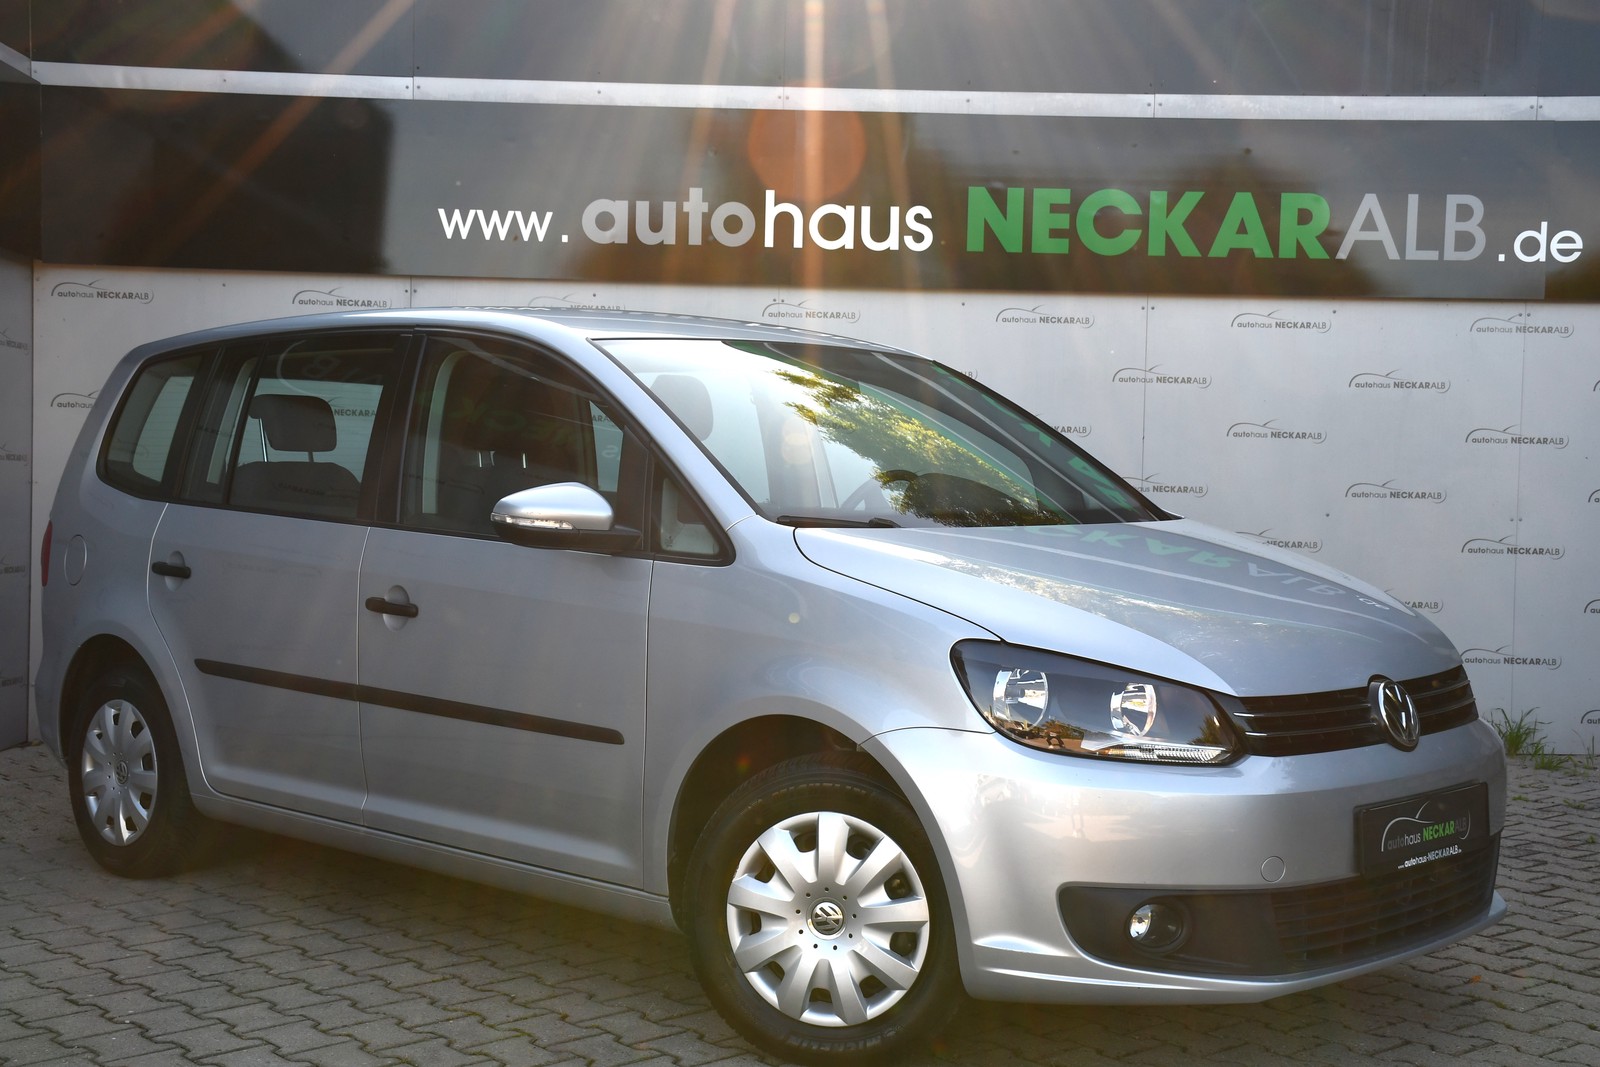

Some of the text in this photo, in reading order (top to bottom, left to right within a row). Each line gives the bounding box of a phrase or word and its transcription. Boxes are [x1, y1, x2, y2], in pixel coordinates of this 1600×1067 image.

[582, 187, 934, 252] autohaus
[965, 185, 1487, 262] NECKARALB
[1498, 221, 1584, 263] .de
[57, 290, 149, 301] autohaus NECKARALB
[298, 298, 388, 308] autohaus NECKARALB
[1040, 316, 1091, 325] NECKARALB
[1275, 321, 1326, 330] NECKARALB
[1516, 325, 1569, 335] NECKARALB
[1119, 376, 1207, 385] autohaus NECKARALB
[1354, 381, 1446, 390] autohaus NECKARALB
[333, 408, 376, 417] NECKARA
[1271, 431, 1322, 440] NECKARALB
[1511, 437, 1564, 445] NECKARALB
[1152, 485, 1204, 494] NECKARALB
[1351, 491, 1442, 500] autohaus NECKARALB
[1507, 547, 1560, 556] NECKARALB
[1464, 656, 1557, 666] autohaus NECKARALB
[1387, 817, 1467, 850] autohaus NECKARALB
